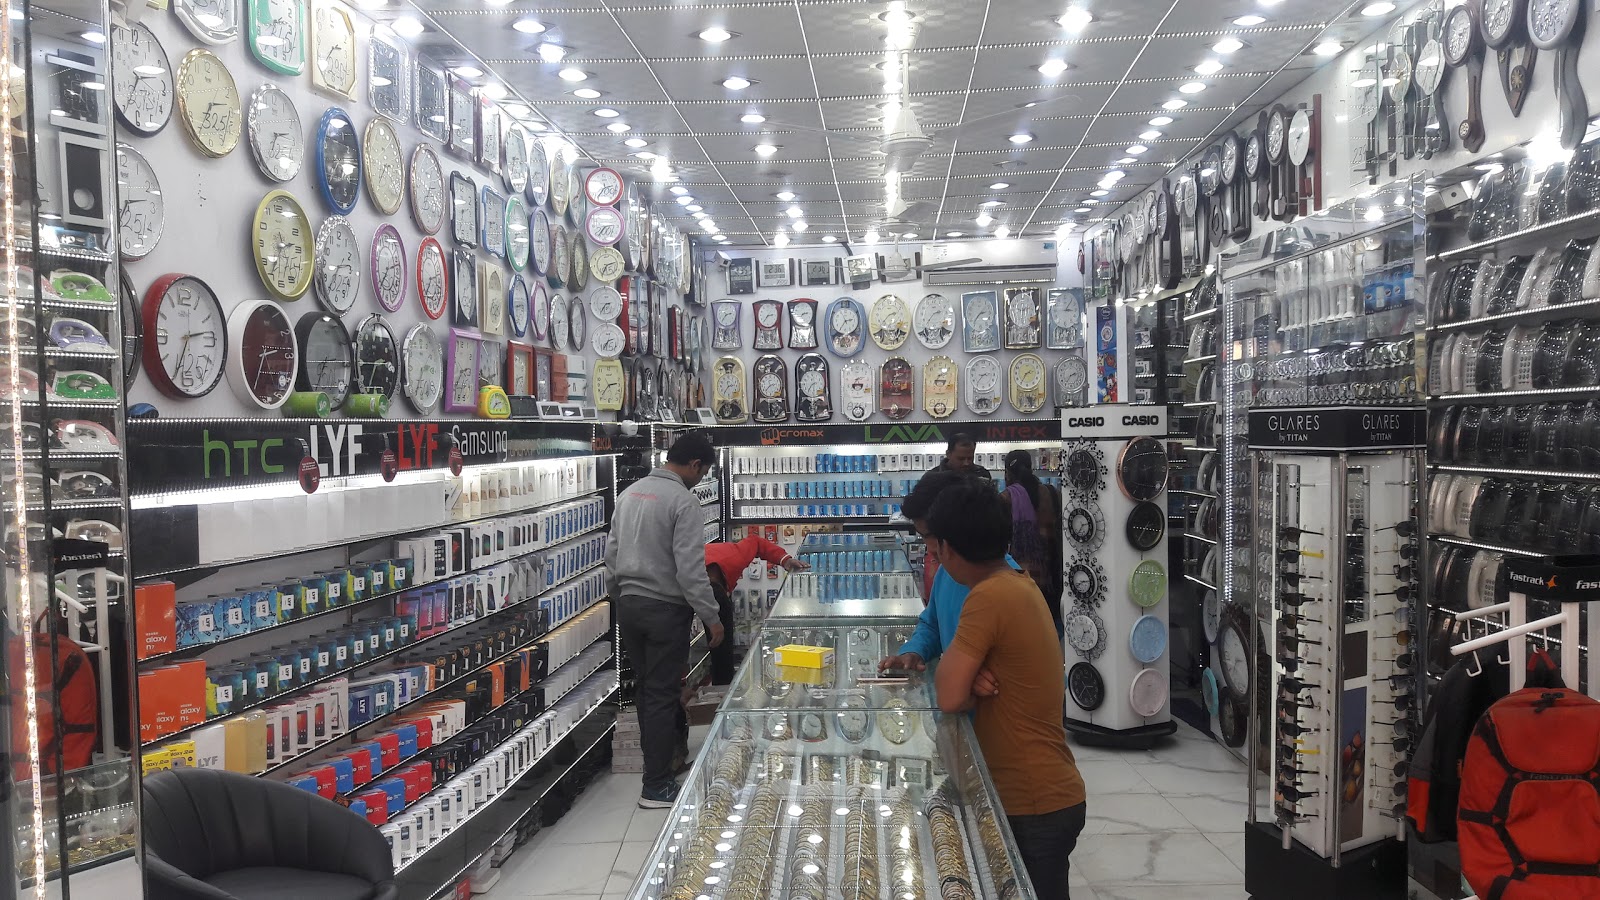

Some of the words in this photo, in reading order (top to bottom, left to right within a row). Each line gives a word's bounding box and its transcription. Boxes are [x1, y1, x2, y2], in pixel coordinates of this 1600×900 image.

[1068, 416, 1105, 428] CASIO
[1122, 415, 1159, 426] CASIO
[1268, 414, 1320, 431] GLARES
[1362, 413, 1400, 431] GLARES
[864, 424, 945, 442] LAVA
[1278, 433, 1286, 442] by
[1286, 433, 1308, 442] TITAN
[1370, 433, 1377, 442] by
[1376, 432, 1392, 441] TITAN
[310, 424, 363, 477] LYF
[398, 423, 439, 470] LYF
[451, 424, 508, 462] Samsung
[1509, 571, 1545, 586] fastrack
[197, 755, 219, 768] LYF
